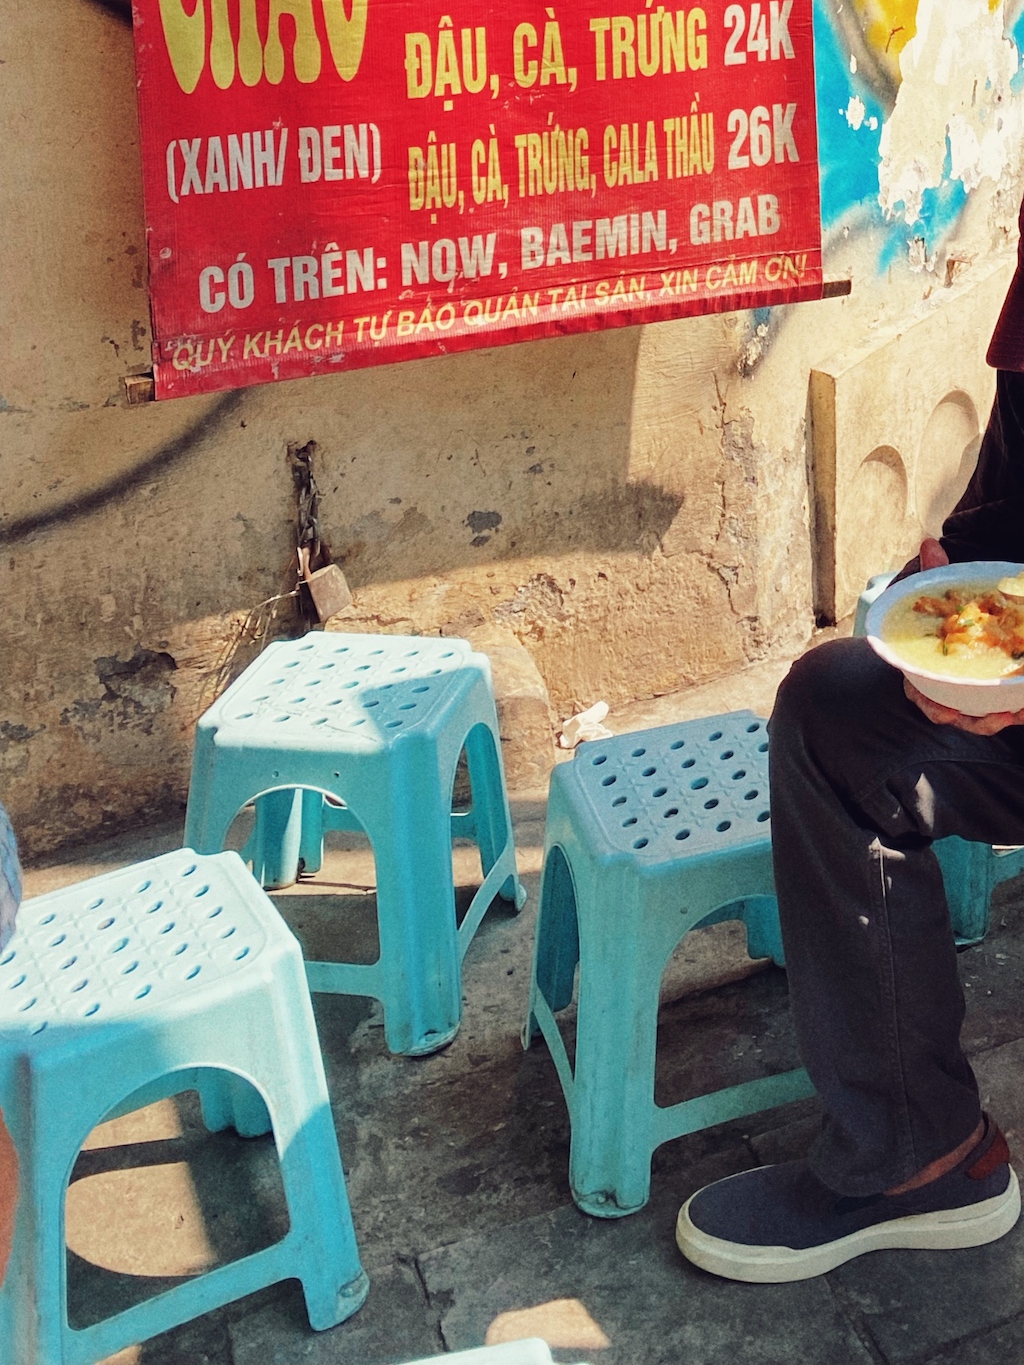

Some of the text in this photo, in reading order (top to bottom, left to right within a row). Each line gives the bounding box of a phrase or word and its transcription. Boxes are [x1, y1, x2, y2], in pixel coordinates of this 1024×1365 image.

[403, 14, 500, 112] ĐẬU,
[512, 6, 578, 93] CÀ,
[165, 121, 383, 204] (XANH/ ĐEN)
[407, 92, 800, 224] ĐẬU, CÀ, TRỨNG, CALA THẦU 26K
[171, 328, 236, 372] QUÝ
[242, 318, 345, 361] KHÁCH
[353, 309, 393, 347] TỰ
[463, 285, 540, 327] QUẢN
[658, 268, 700, 297] XIN
[705, 253, 759, 291] CẢM
[199, 193, 782, 314] CÓ TRÊN: NOW, BAEMIN, GRAB
